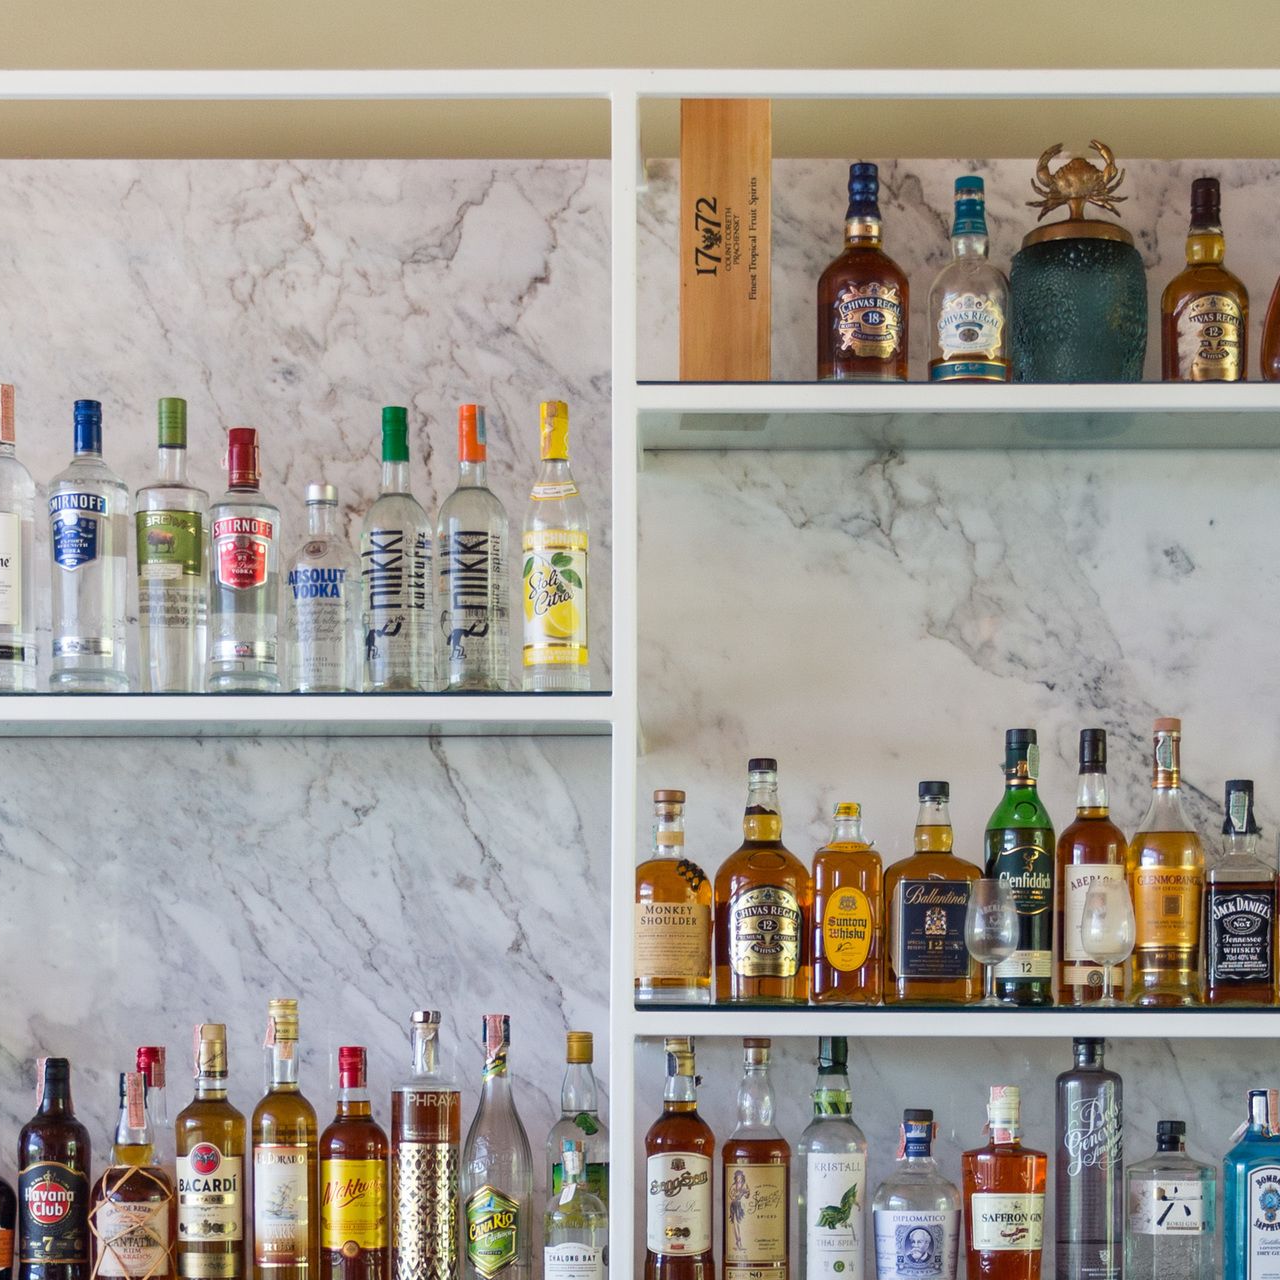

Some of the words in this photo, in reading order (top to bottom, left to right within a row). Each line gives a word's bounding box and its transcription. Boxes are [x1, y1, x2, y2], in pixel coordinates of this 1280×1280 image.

[748, 177, 757, 205] Spirits
[748, 209, 757, 235] Fruit
[748, 236, 757, 275] Tropical
[748, 276, 757, 300] Finest
[842, 299, 874, 314] CHIVAS
[876, 299, 900, 314] REGAL
[868, 312, 879, 324] 18
[939, 312, 969, 330] CHIVAS
[970, 312, 999, 328] REGAL
[1209, 326, 1219, 336] 12
[214, 517, 271, 536] SMIRNOFF
[288, 568, 346, 586] ABSOLUT
[529, 569, 560, 600] Stoli
[292, 584, 340, 600] VODKA
[999, 872, 1051, 888] Glenfiddich
[645, 905, 693, 915] MONKEY
[736, 906, 769, 919] CHIVAS
[770, 906, 798, 920] REGAL
[1213, 902, 1235, 920] JACK
[1236, 897, 1271, 919] DANIEL'S
[640, 916, 697, 926] SHOULDER
[763, 920, 772, 930] 12
[827, 917, 867, 929] Suntory
[828, 928, 865, 941] Whisky
[1222, 934, 1262, 943] Tennessee
[753, 946, 781, 954] WHISKY
[1021, 963, 1032, 973] 12
[407, 1094, 458, 1106] PHRAYA
[814, 1162, 862, 1172] KRISTALL
[179, 1174, 237, 1192] BACARDÍ
[25, 1187, 74, 1202] Havana
[33, 1201, 63, 1216] Club
[1157, 1186, 1202, 1226] 六
[982, 1214, 1028, 1222] SAFFRON
[1030, 1214, 1042, 1222] GIN
[42, 1236, 53, 1252] 7
[816, 1239, 836, 1247] THAI
